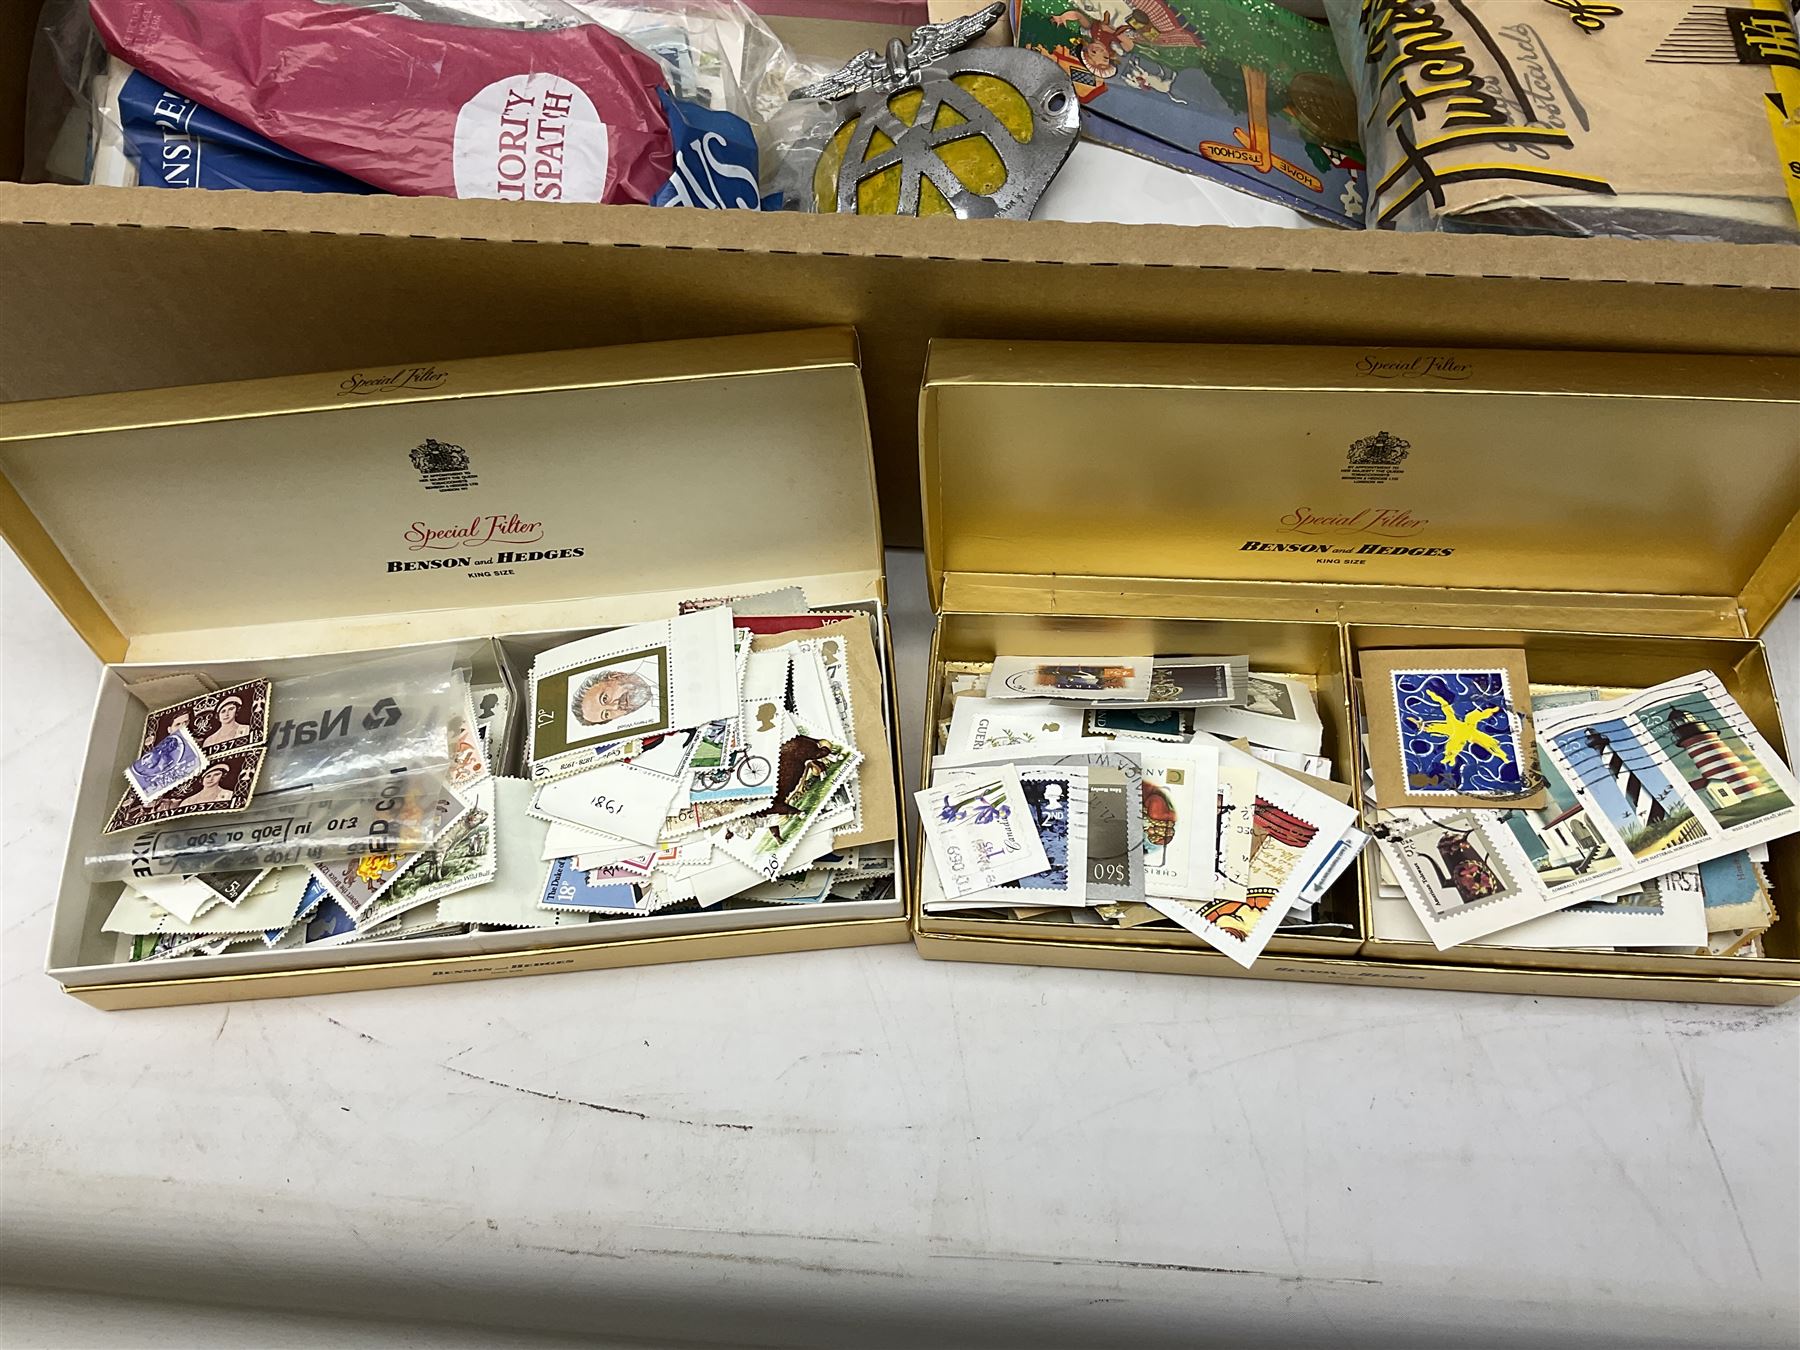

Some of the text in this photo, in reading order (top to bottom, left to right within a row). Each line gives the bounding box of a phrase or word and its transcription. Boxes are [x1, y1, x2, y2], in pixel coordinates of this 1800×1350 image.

[498, 89, 536, 202] IORITY
[1280, 161, 1313, 186] HOME
[1355, 356, 1473, 381] Special Filter
[337, 367, 448, 396] Special Filter
[404, 513, 544, 551] Special Filter
[1276, 506, 1429, 538] Special Filter
[386, 547, 585, 573] BENSON and HEDGES
[1239, 541, 1455, 558] BENSON and HEDGES
[1316, 557, 1341, 565] KING
[467, 568, 516, 579] KING SIZE
[208, 741, 235, 755] 1937
[183, 802, 214, 813] 1937
[1041, 810, 1065, 828] 2ND
[1092, 863, 1126, 882] $60
